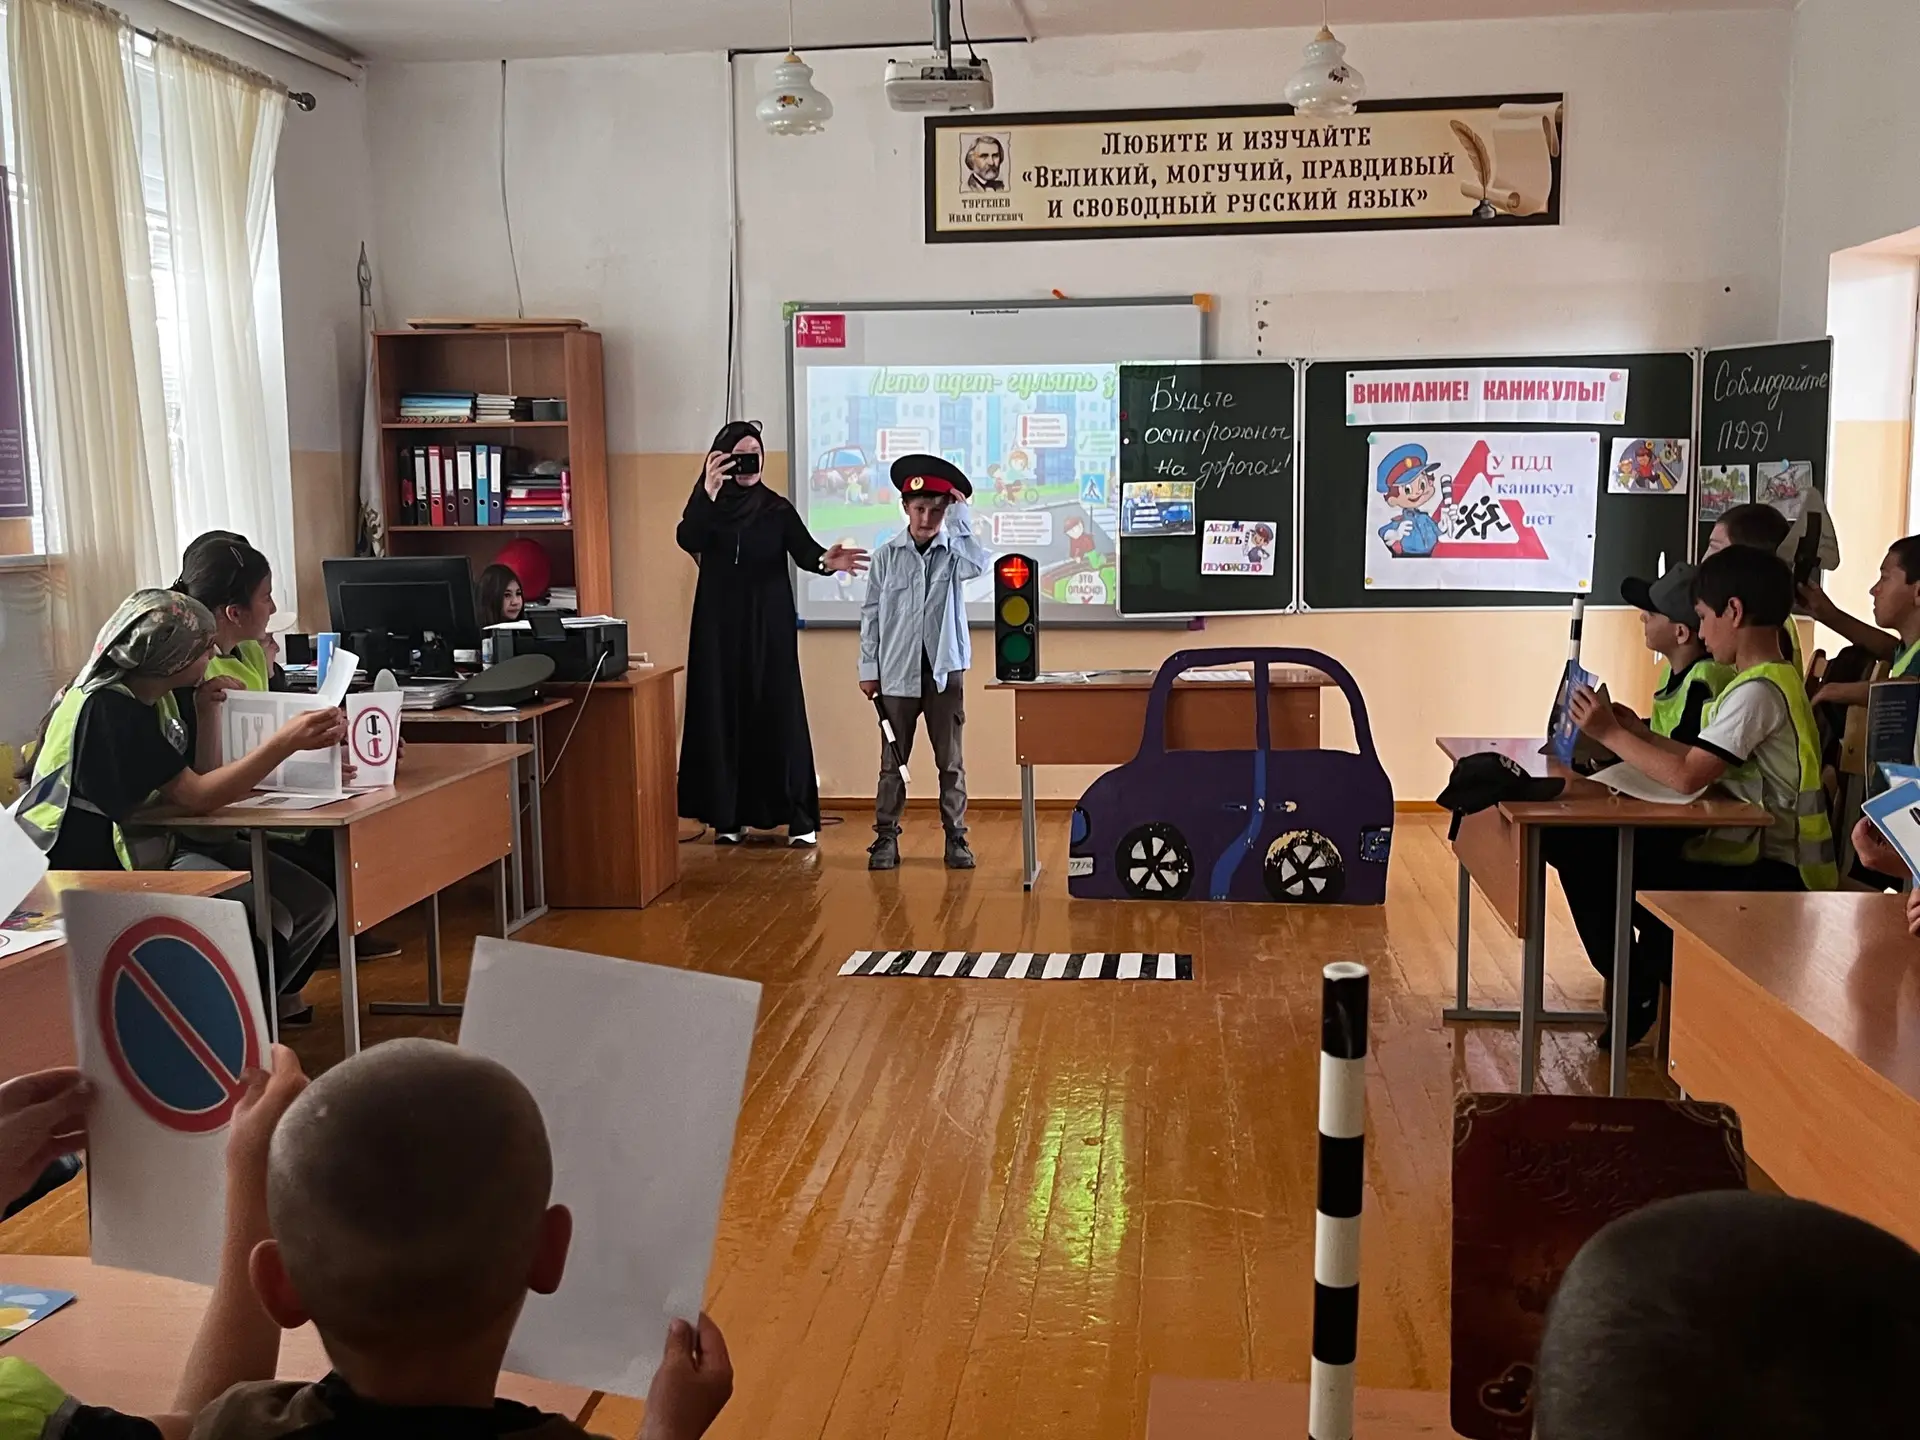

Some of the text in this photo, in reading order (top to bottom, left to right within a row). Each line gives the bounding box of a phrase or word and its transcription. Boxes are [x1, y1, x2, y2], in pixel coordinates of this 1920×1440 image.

[1101, 124, 1372, 156] ЛЮБИТЕ И ИЗУЧАЙТЕ
[1022, 152, 1455, 189] «ВЕЛИКИЙ, МОГУЧИЙ, ПРАВДИВЫЙ
[1047, 187, 1428, 220] И СВОБОДНЫЙ РУССКИЙ ЯЗЫК»
[869, 365, 929, 396] Лето
[1006, 371, 1098, 400] гулять
[1150, 374, 1237, 414] Будьте
[1352, 380, 1606, 404] ВНИМАНИЕ! КАНИКУЛЫ!
[1714, 359, 1828, 411] Соблюдайте
[1144, 420, 1292, 455] осторожны
[1492, 455, 1553, 472] У ПДД
[1497, 483, 1574, 498] каникул
[1525, 515, 1555, 525] нет
